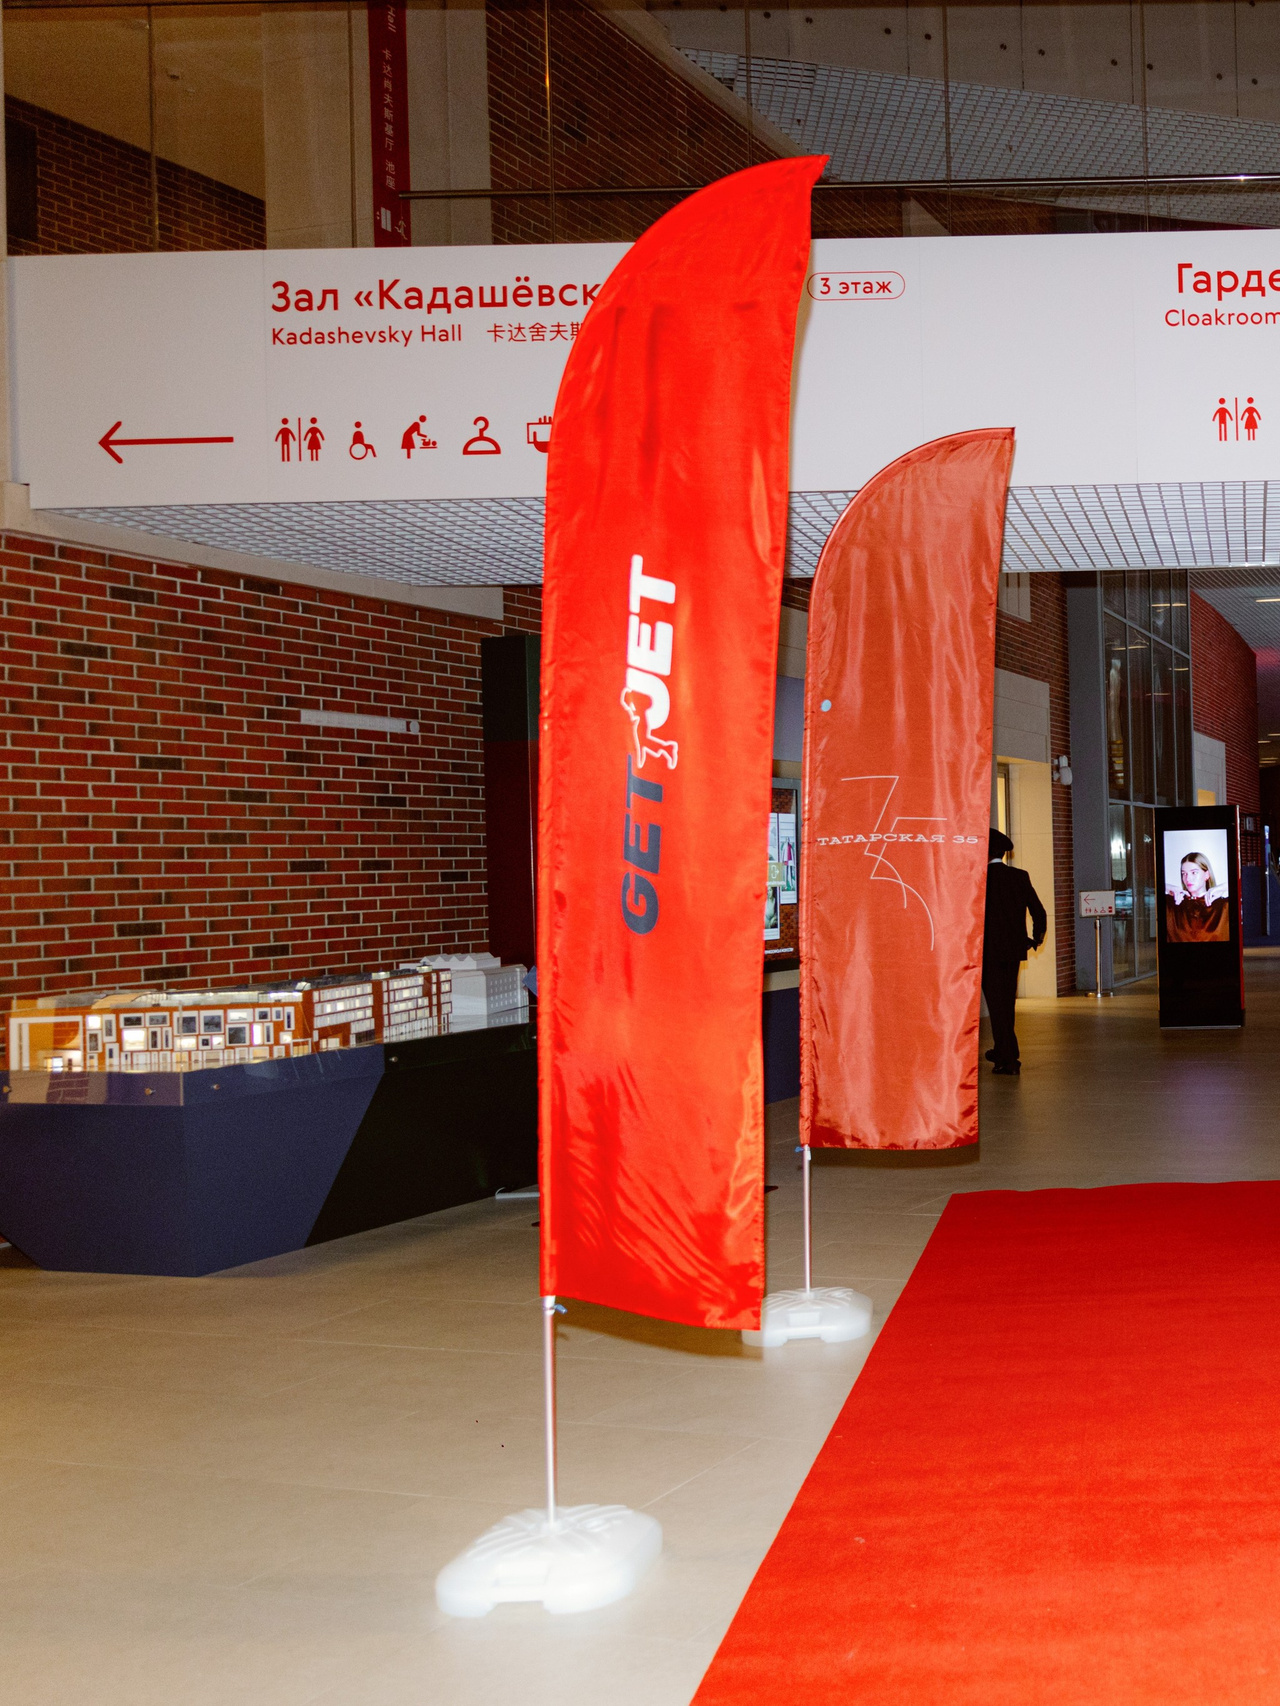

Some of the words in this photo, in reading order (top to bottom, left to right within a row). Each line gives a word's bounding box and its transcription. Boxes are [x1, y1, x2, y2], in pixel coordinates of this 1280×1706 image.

[271, 280, 340, 313] Зал
[354, 275, 602, 315] «Кадашёвск
[820, 277, 831, 295] 3
[838, 281, 893, 295] этаж
[271, 325, 413, 347] Kadashevsky
[420, 324, 462, 343] Hall
[817, 833, 946, 846] ТАТАРСКАЯ
[952, 835, 979, 844] 35
